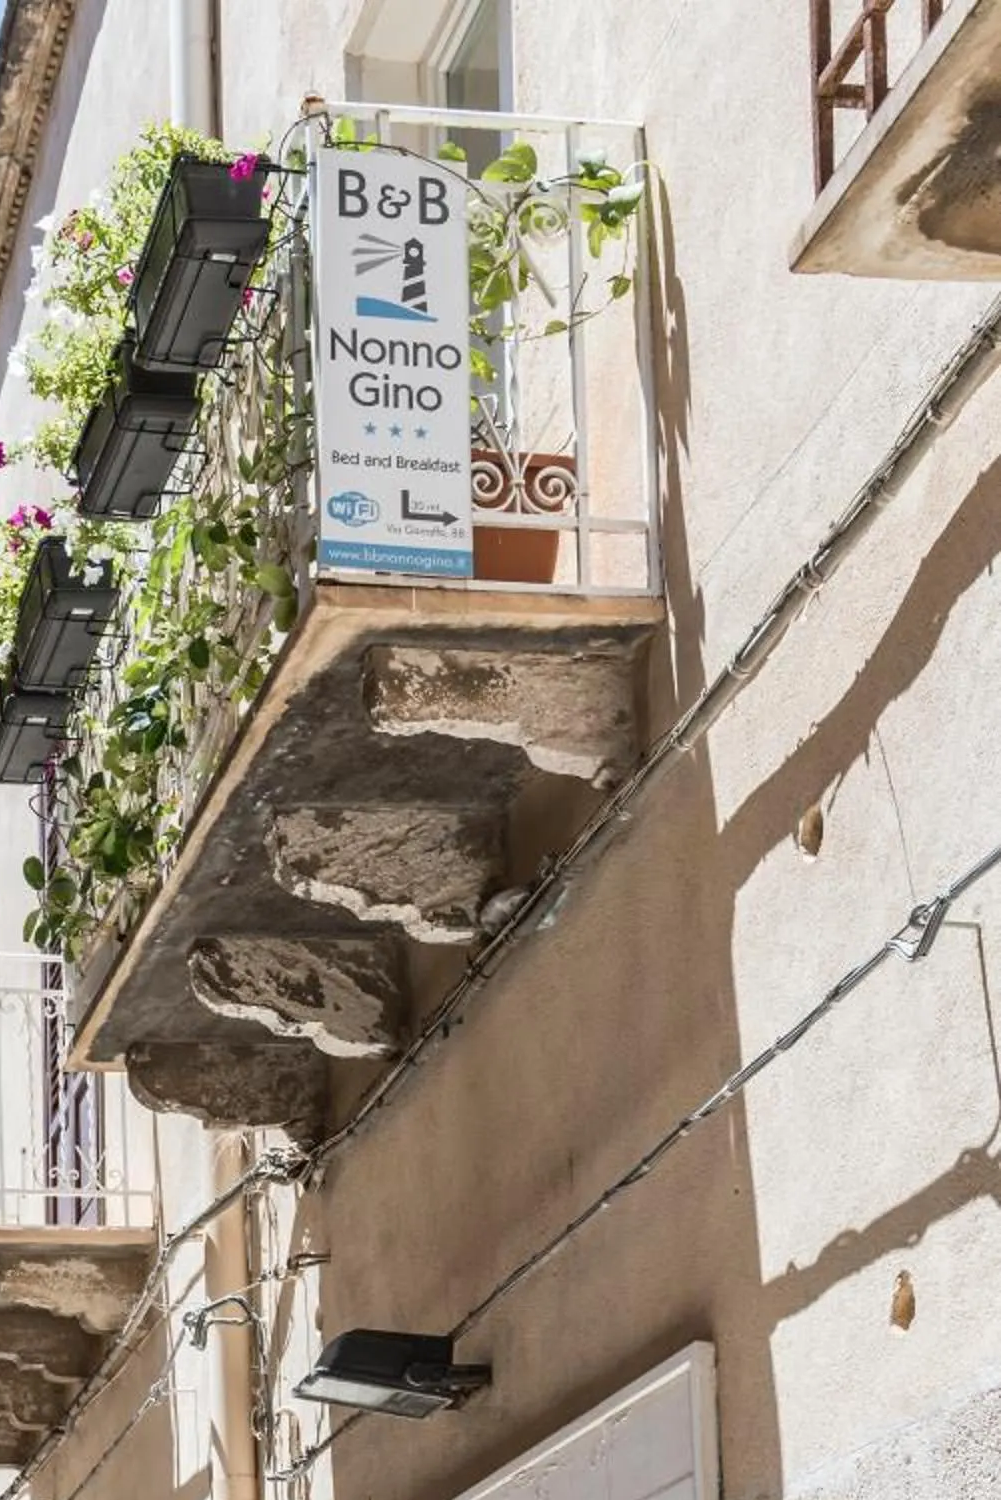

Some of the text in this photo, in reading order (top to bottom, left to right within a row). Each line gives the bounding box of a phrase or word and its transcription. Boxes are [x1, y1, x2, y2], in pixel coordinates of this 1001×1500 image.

[329, 326, 462, 371] Nonno
[349, 371, 443, 412] Gino
[332, 450, 461, 474] Bed and Breakfast
